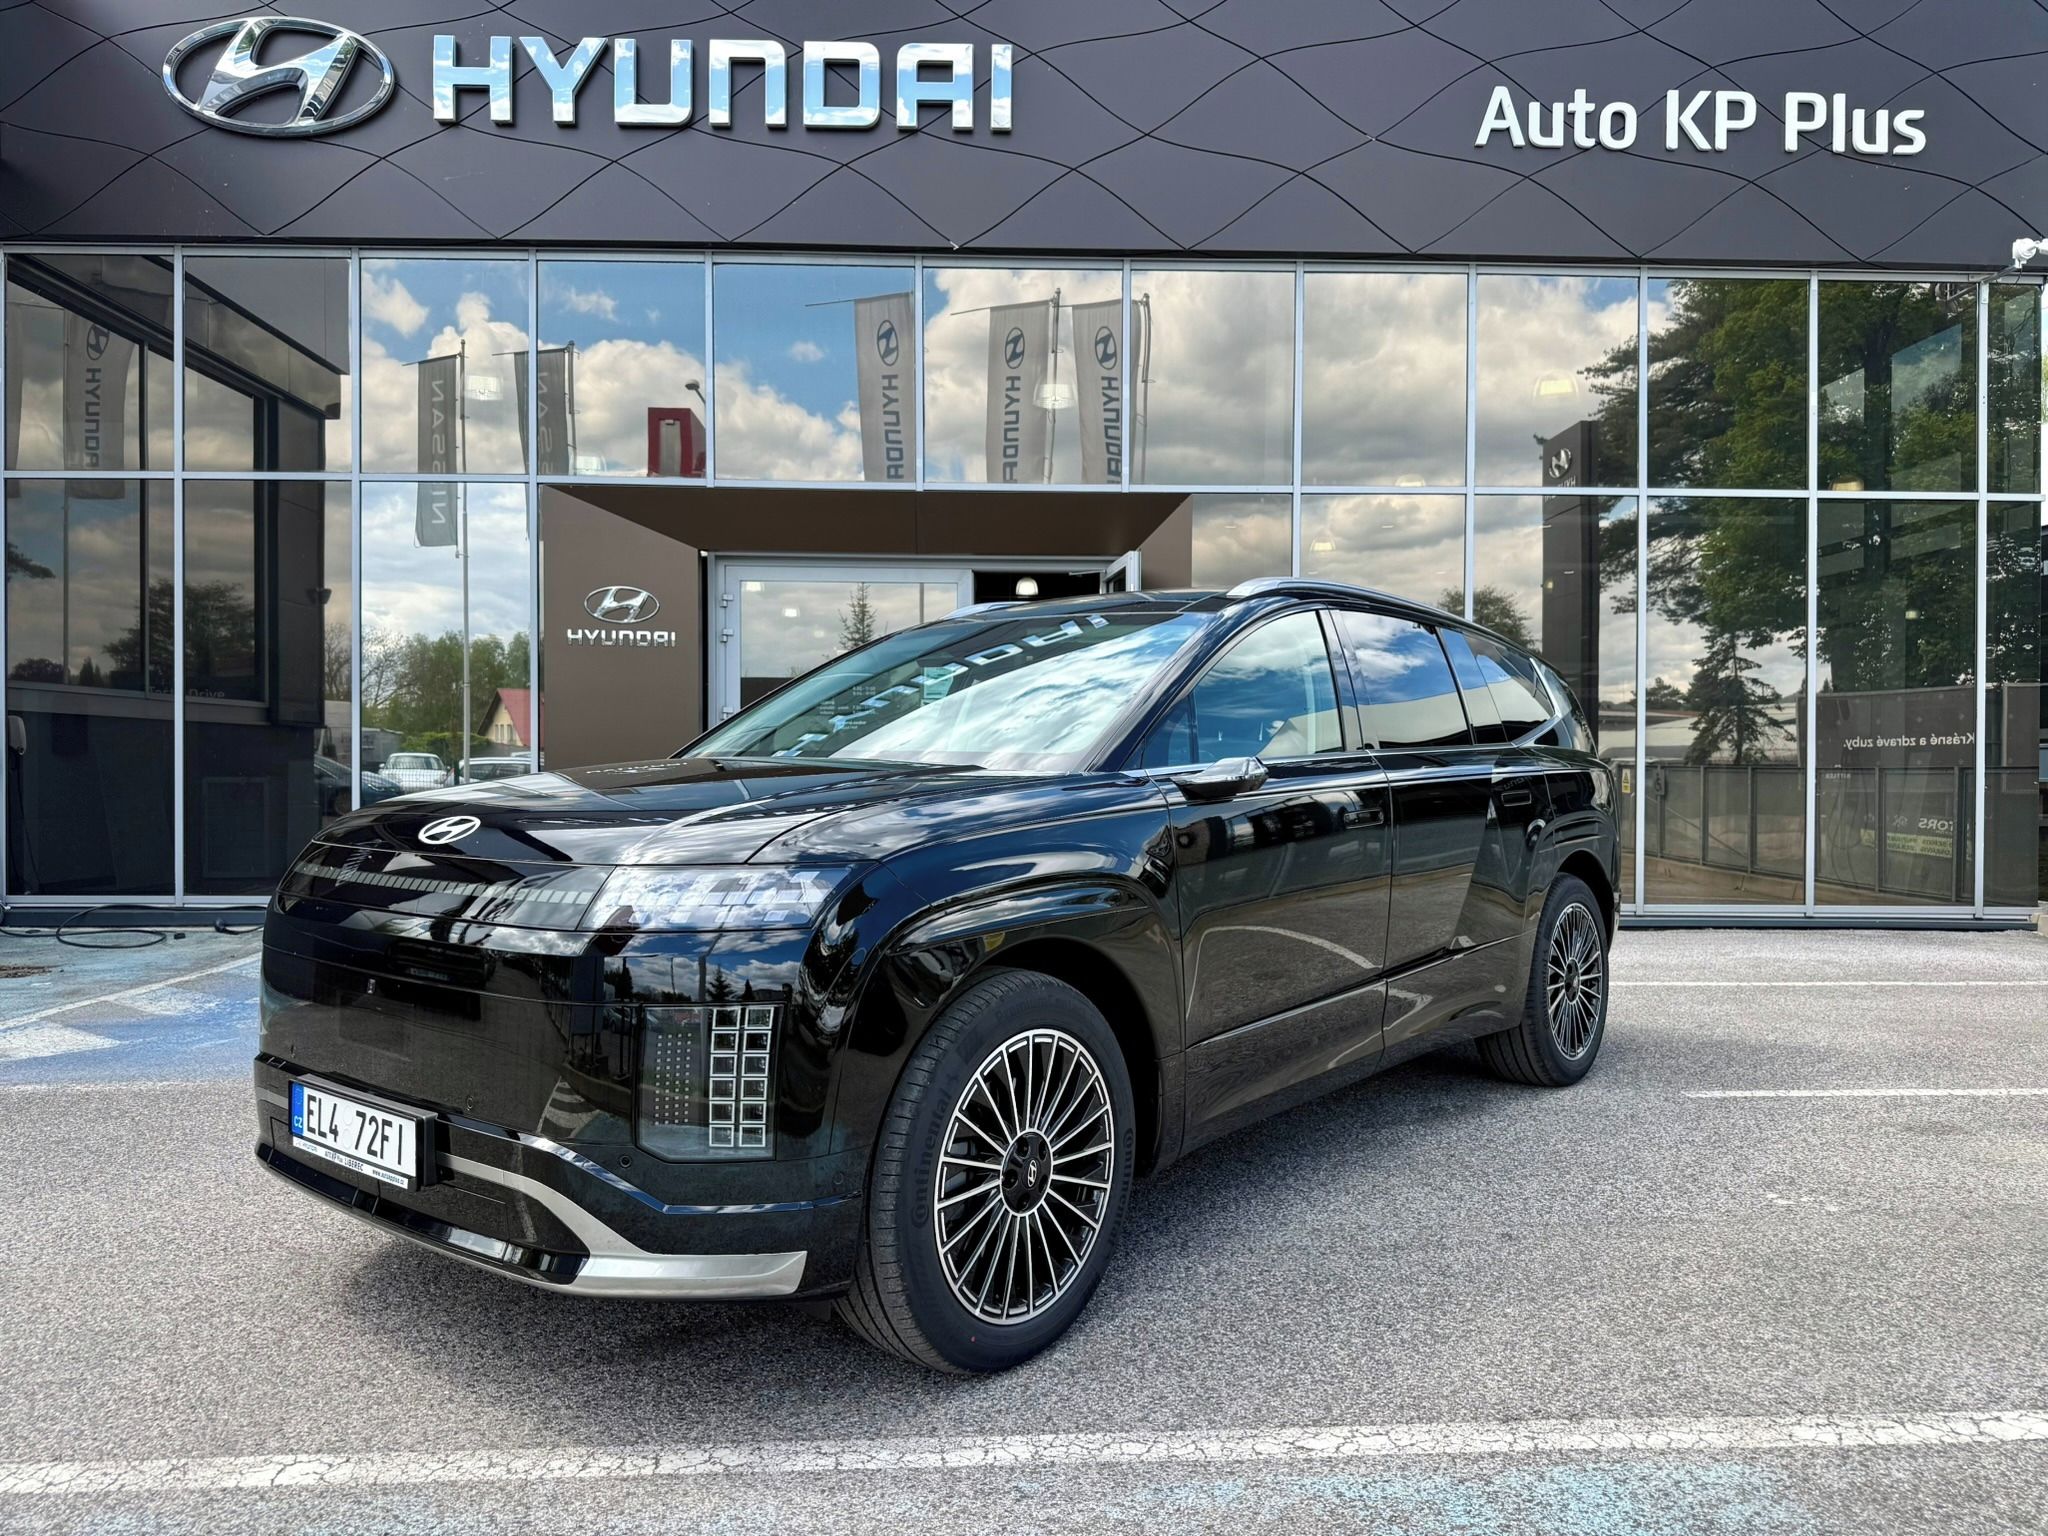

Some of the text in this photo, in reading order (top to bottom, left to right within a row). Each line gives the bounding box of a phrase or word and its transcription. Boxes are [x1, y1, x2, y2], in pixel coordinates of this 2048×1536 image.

[432, 34, 1013, 132] HYUNDAI
[1475, 86, 1927, 156] Auto KP Plus
[85, 368, 102, 468] HYUNDA
[567, 628, 676, 647] HYUNDAI
[294, 1115, 303, 1129] CZ
[307, 1094, 338, 1142] EL4
